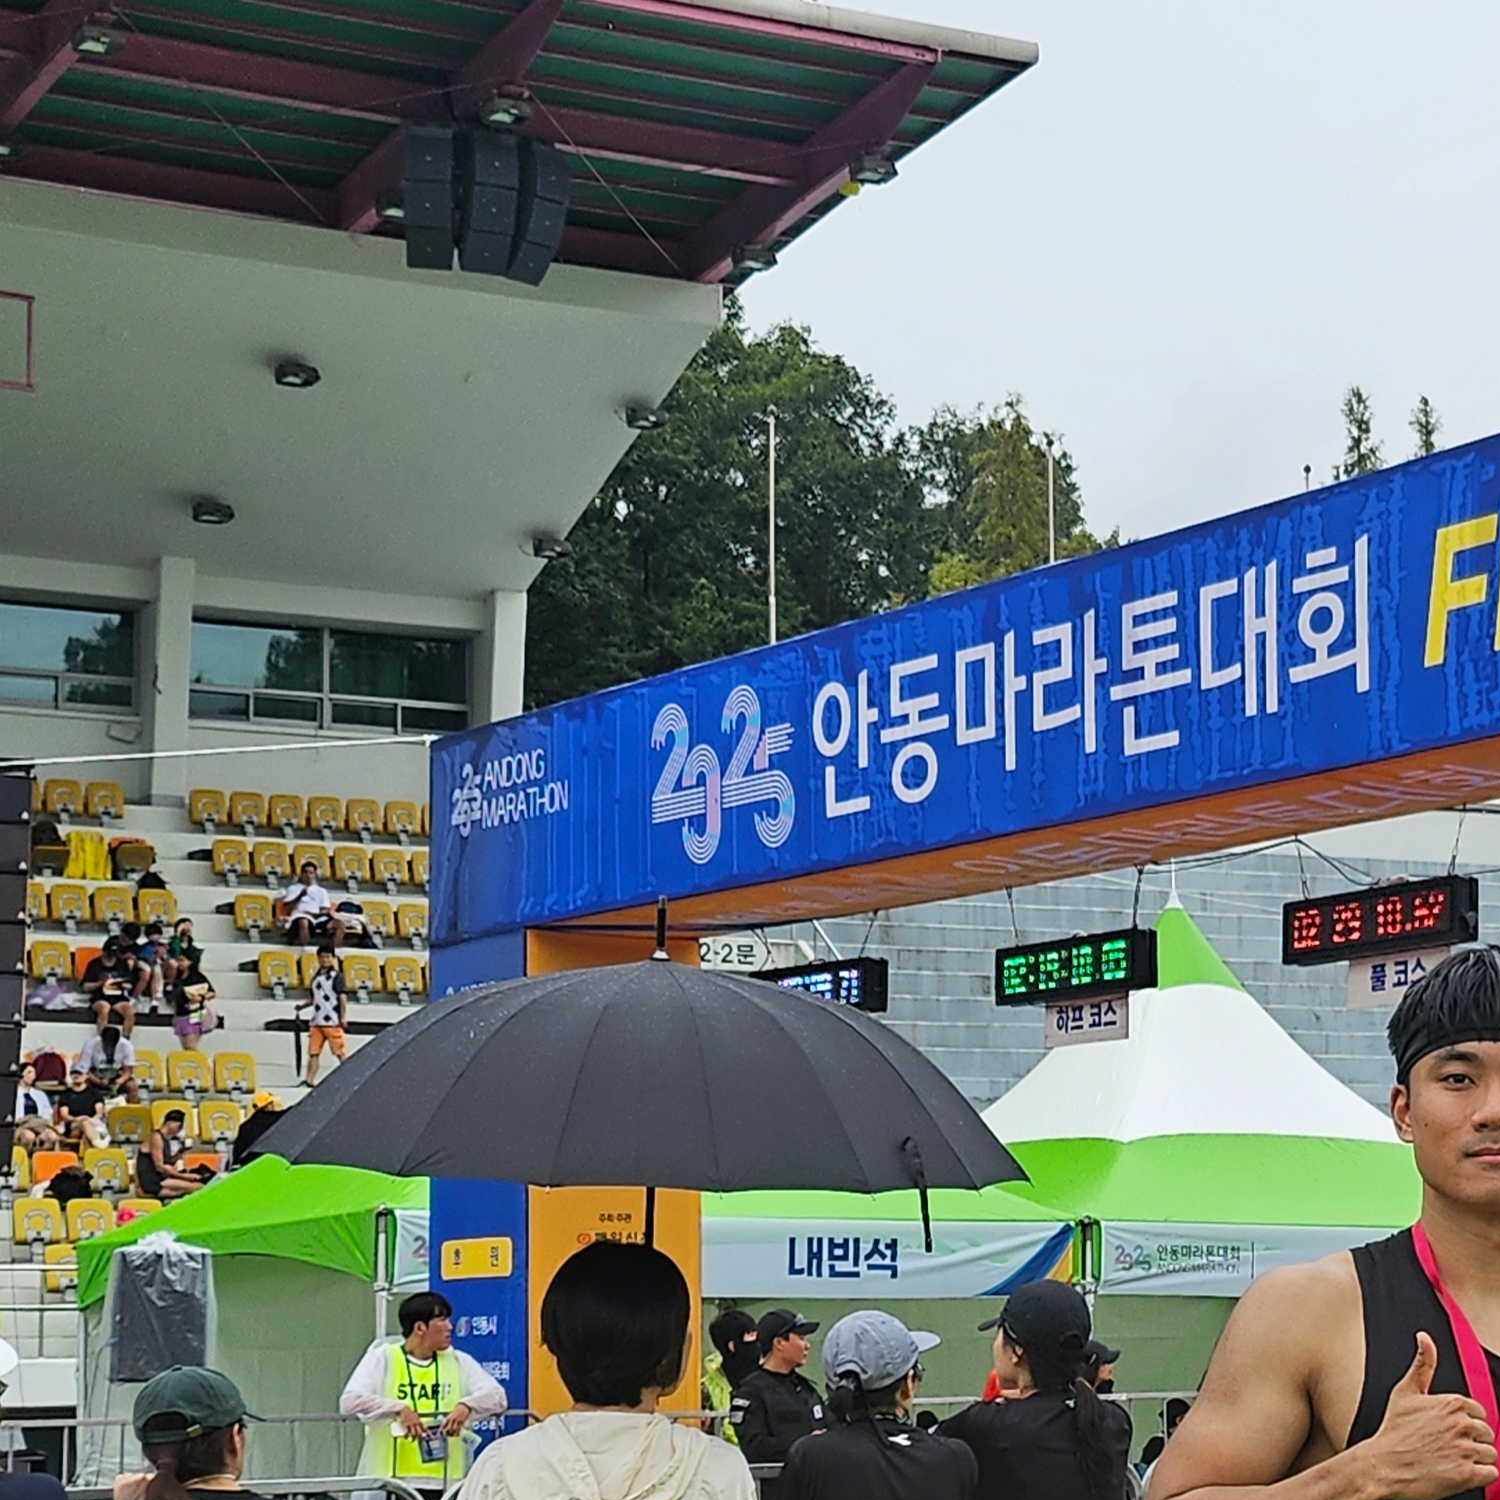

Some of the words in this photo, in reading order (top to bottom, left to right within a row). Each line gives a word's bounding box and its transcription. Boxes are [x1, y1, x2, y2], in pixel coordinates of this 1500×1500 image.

[813, 533, 1371, 820] 안동마라톤대회
[482, 748, 546, 792] ANDONG
[651, 683, 797, 864] 2025
[482, 779, 569, 831] MARATHON
[699, 941, 757, 966] 2-2문
[1369, 962, 1388, 992] 풀
[1056, 1004, 1085, 1035] 하프
[1088, 1000, 1118, 1030] 코스
[787, 1236, 899, 1279] 내빈석
[1156, 1243, 1241, 1263] 안동마라톤대회
